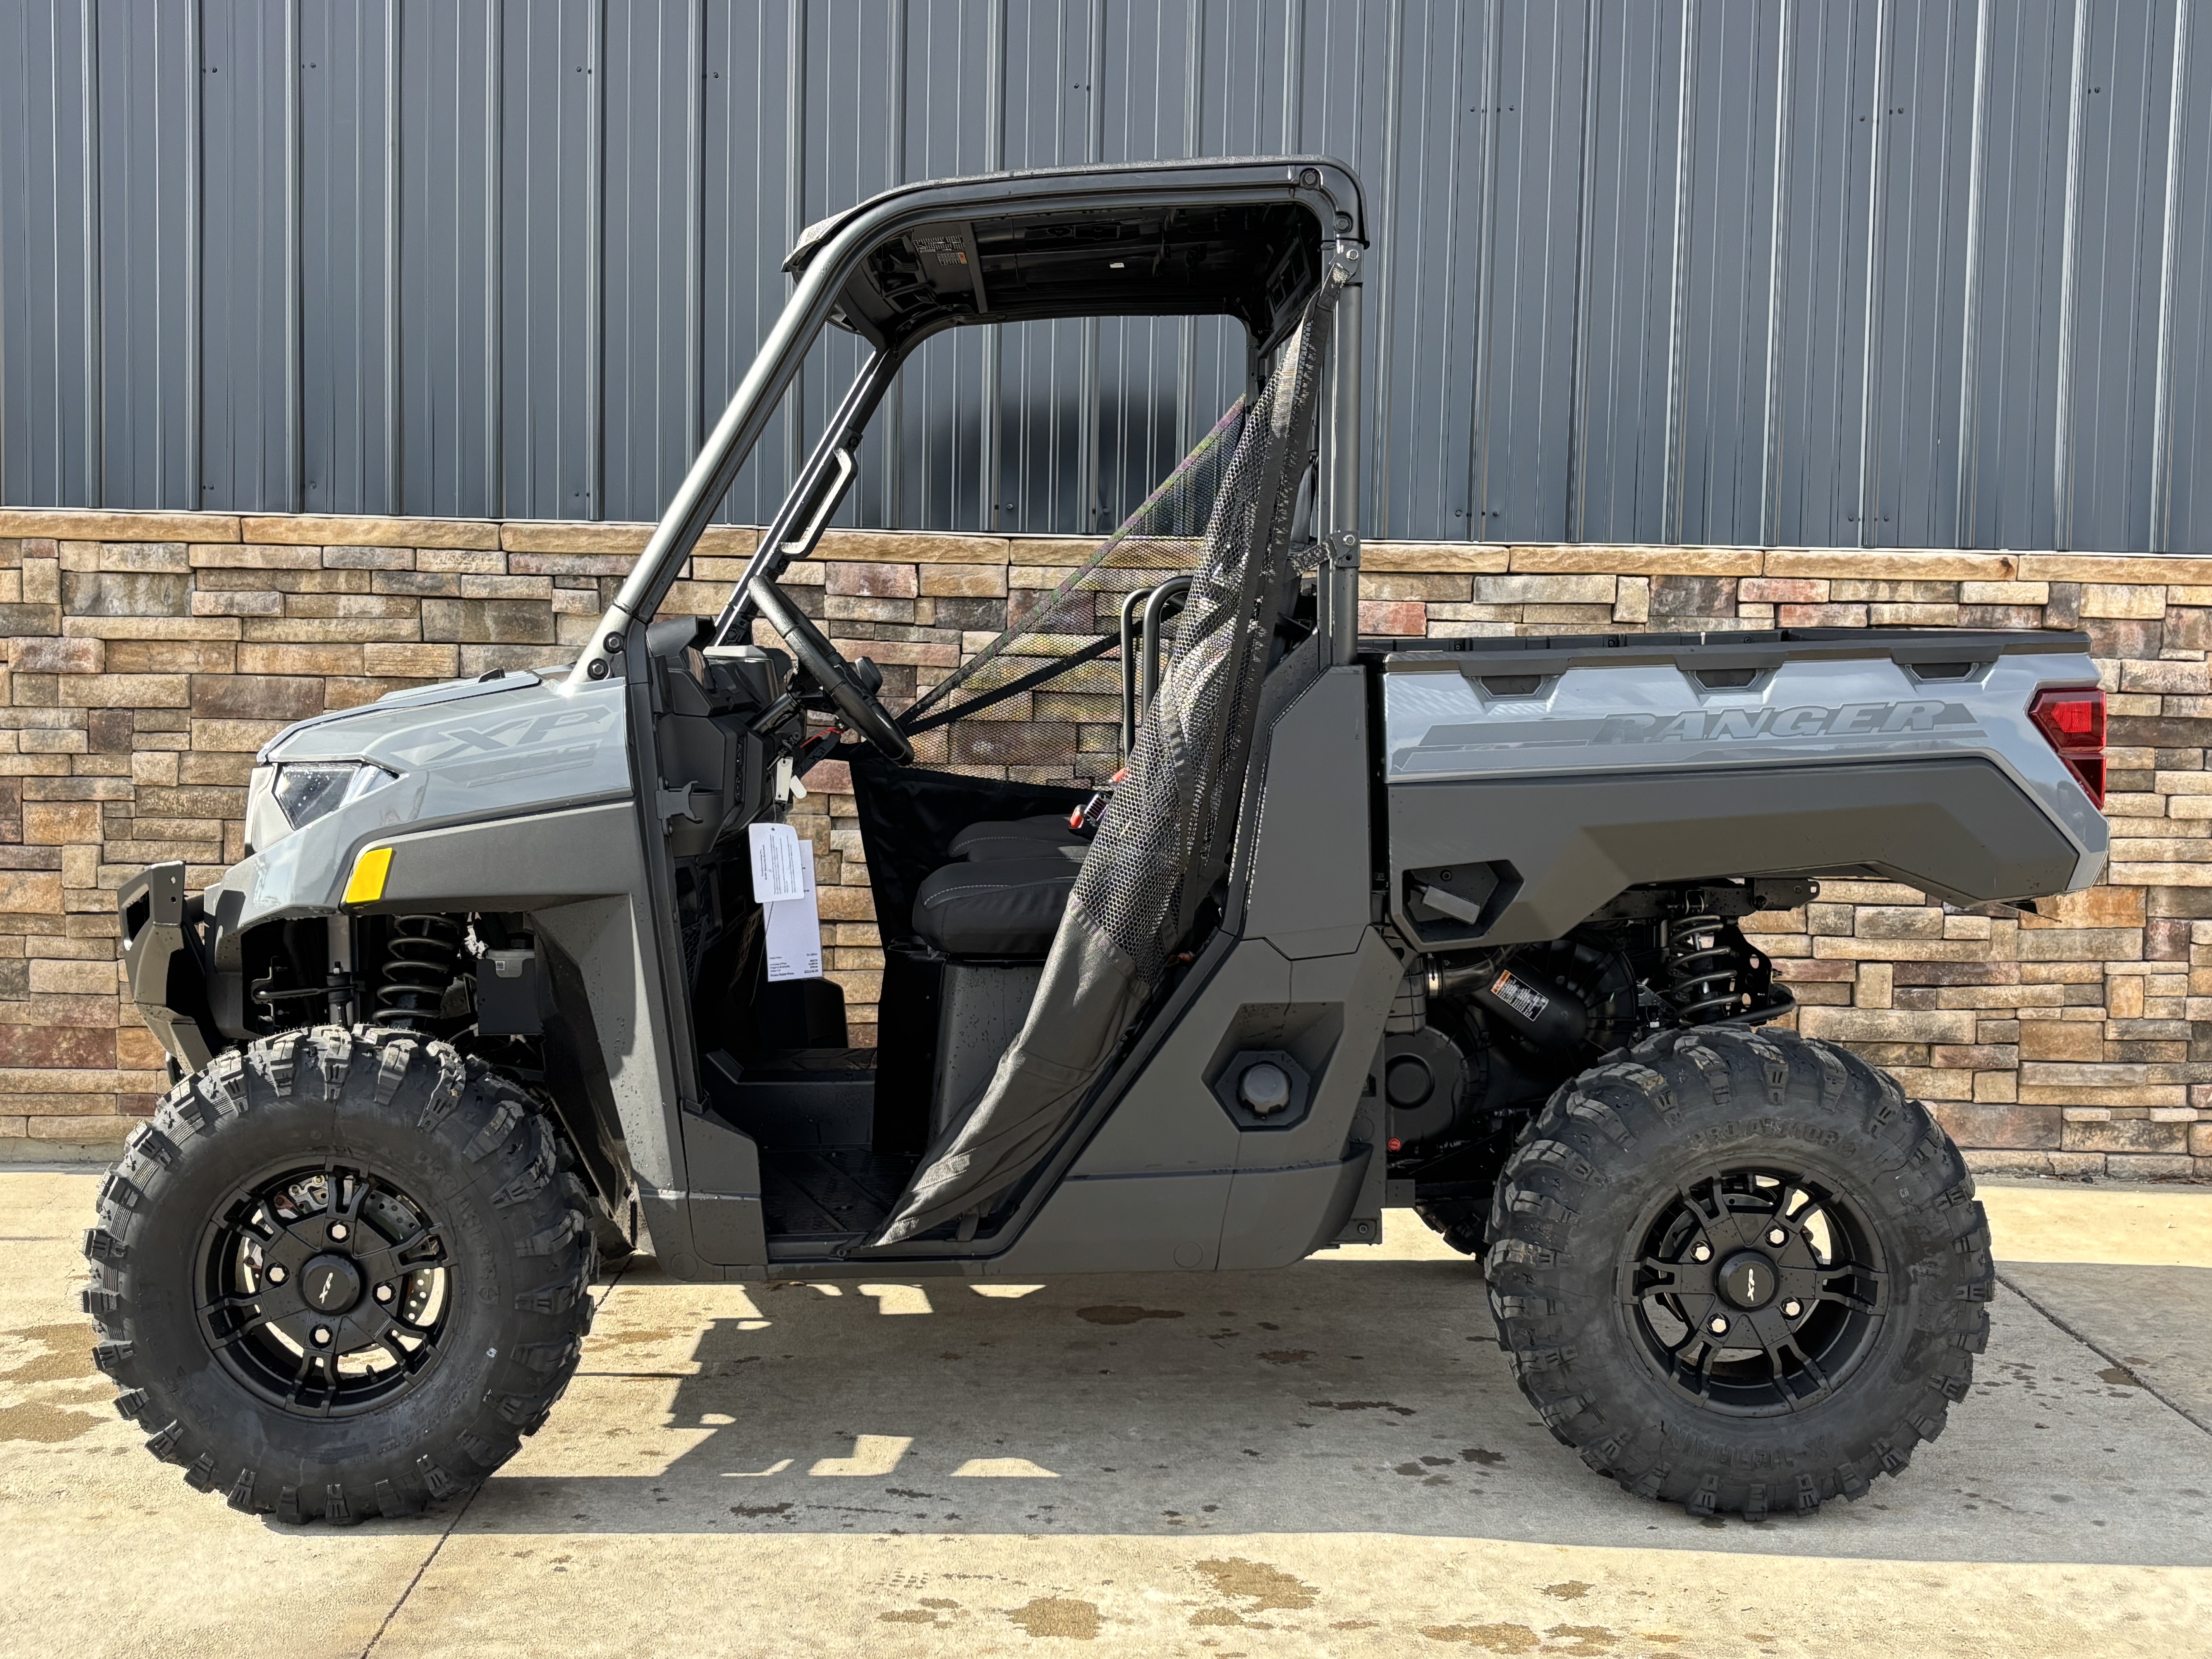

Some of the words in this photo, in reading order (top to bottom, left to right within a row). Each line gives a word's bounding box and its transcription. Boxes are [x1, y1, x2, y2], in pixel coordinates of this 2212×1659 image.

[426, 706, 612, 763] XP
[1589, 700, 1945, 744] RANGER
[1687, 1120, 1739, 1150] PRO
[1745, 1118, 1839, 1146] ARMOR
[319, 1272, 333, 1304] XP
[1747, 1268, 1755, 1302] XP
